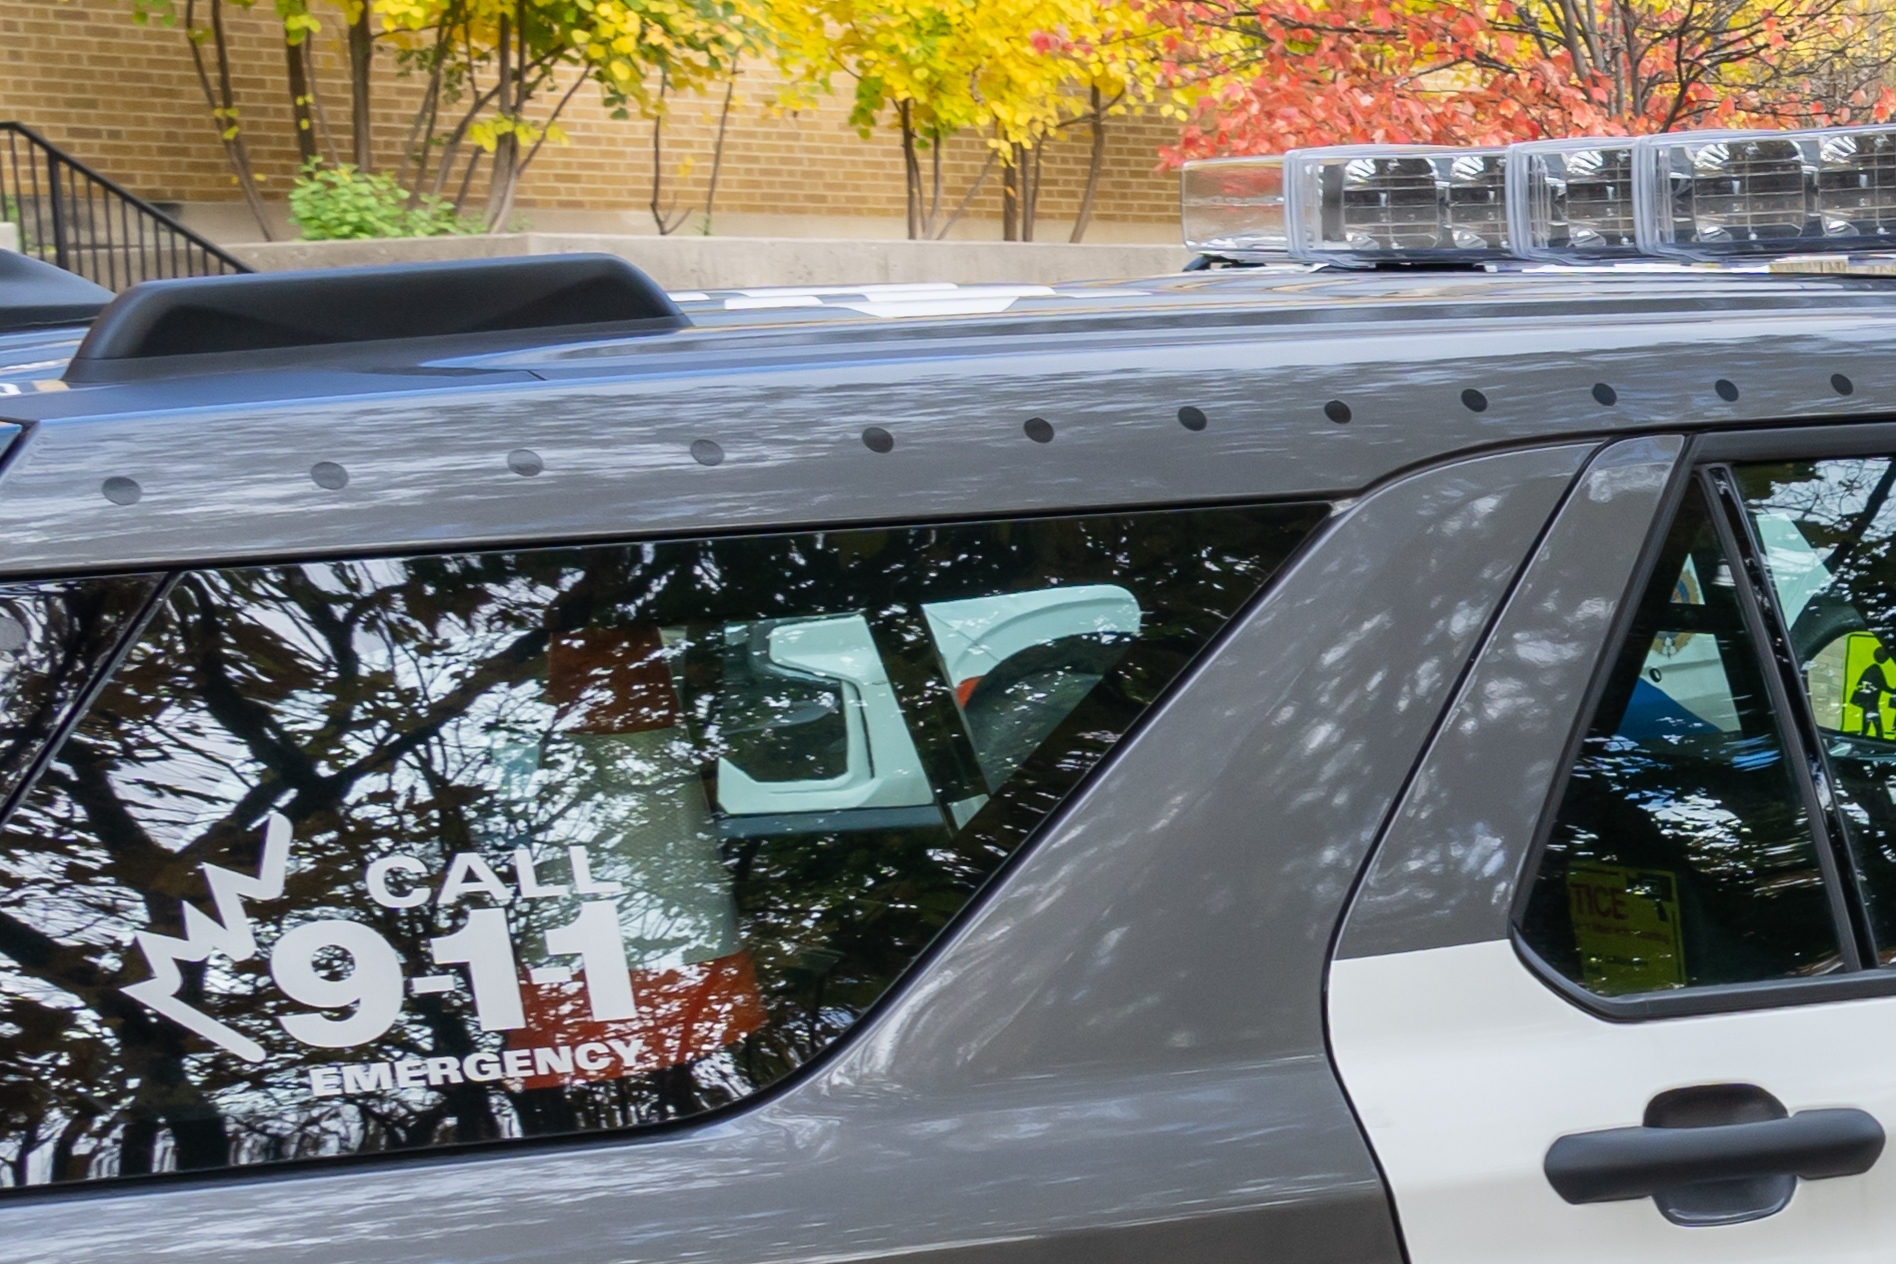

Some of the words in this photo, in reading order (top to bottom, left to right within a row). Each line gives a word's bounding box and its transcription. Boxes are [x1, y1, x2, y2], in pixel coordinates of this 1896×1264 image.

[365, 845, 623, 908] CALL
[269, 899, 638, 1048] 9-1-1
[308, 1038, 645, 1098] EMERGENCY
